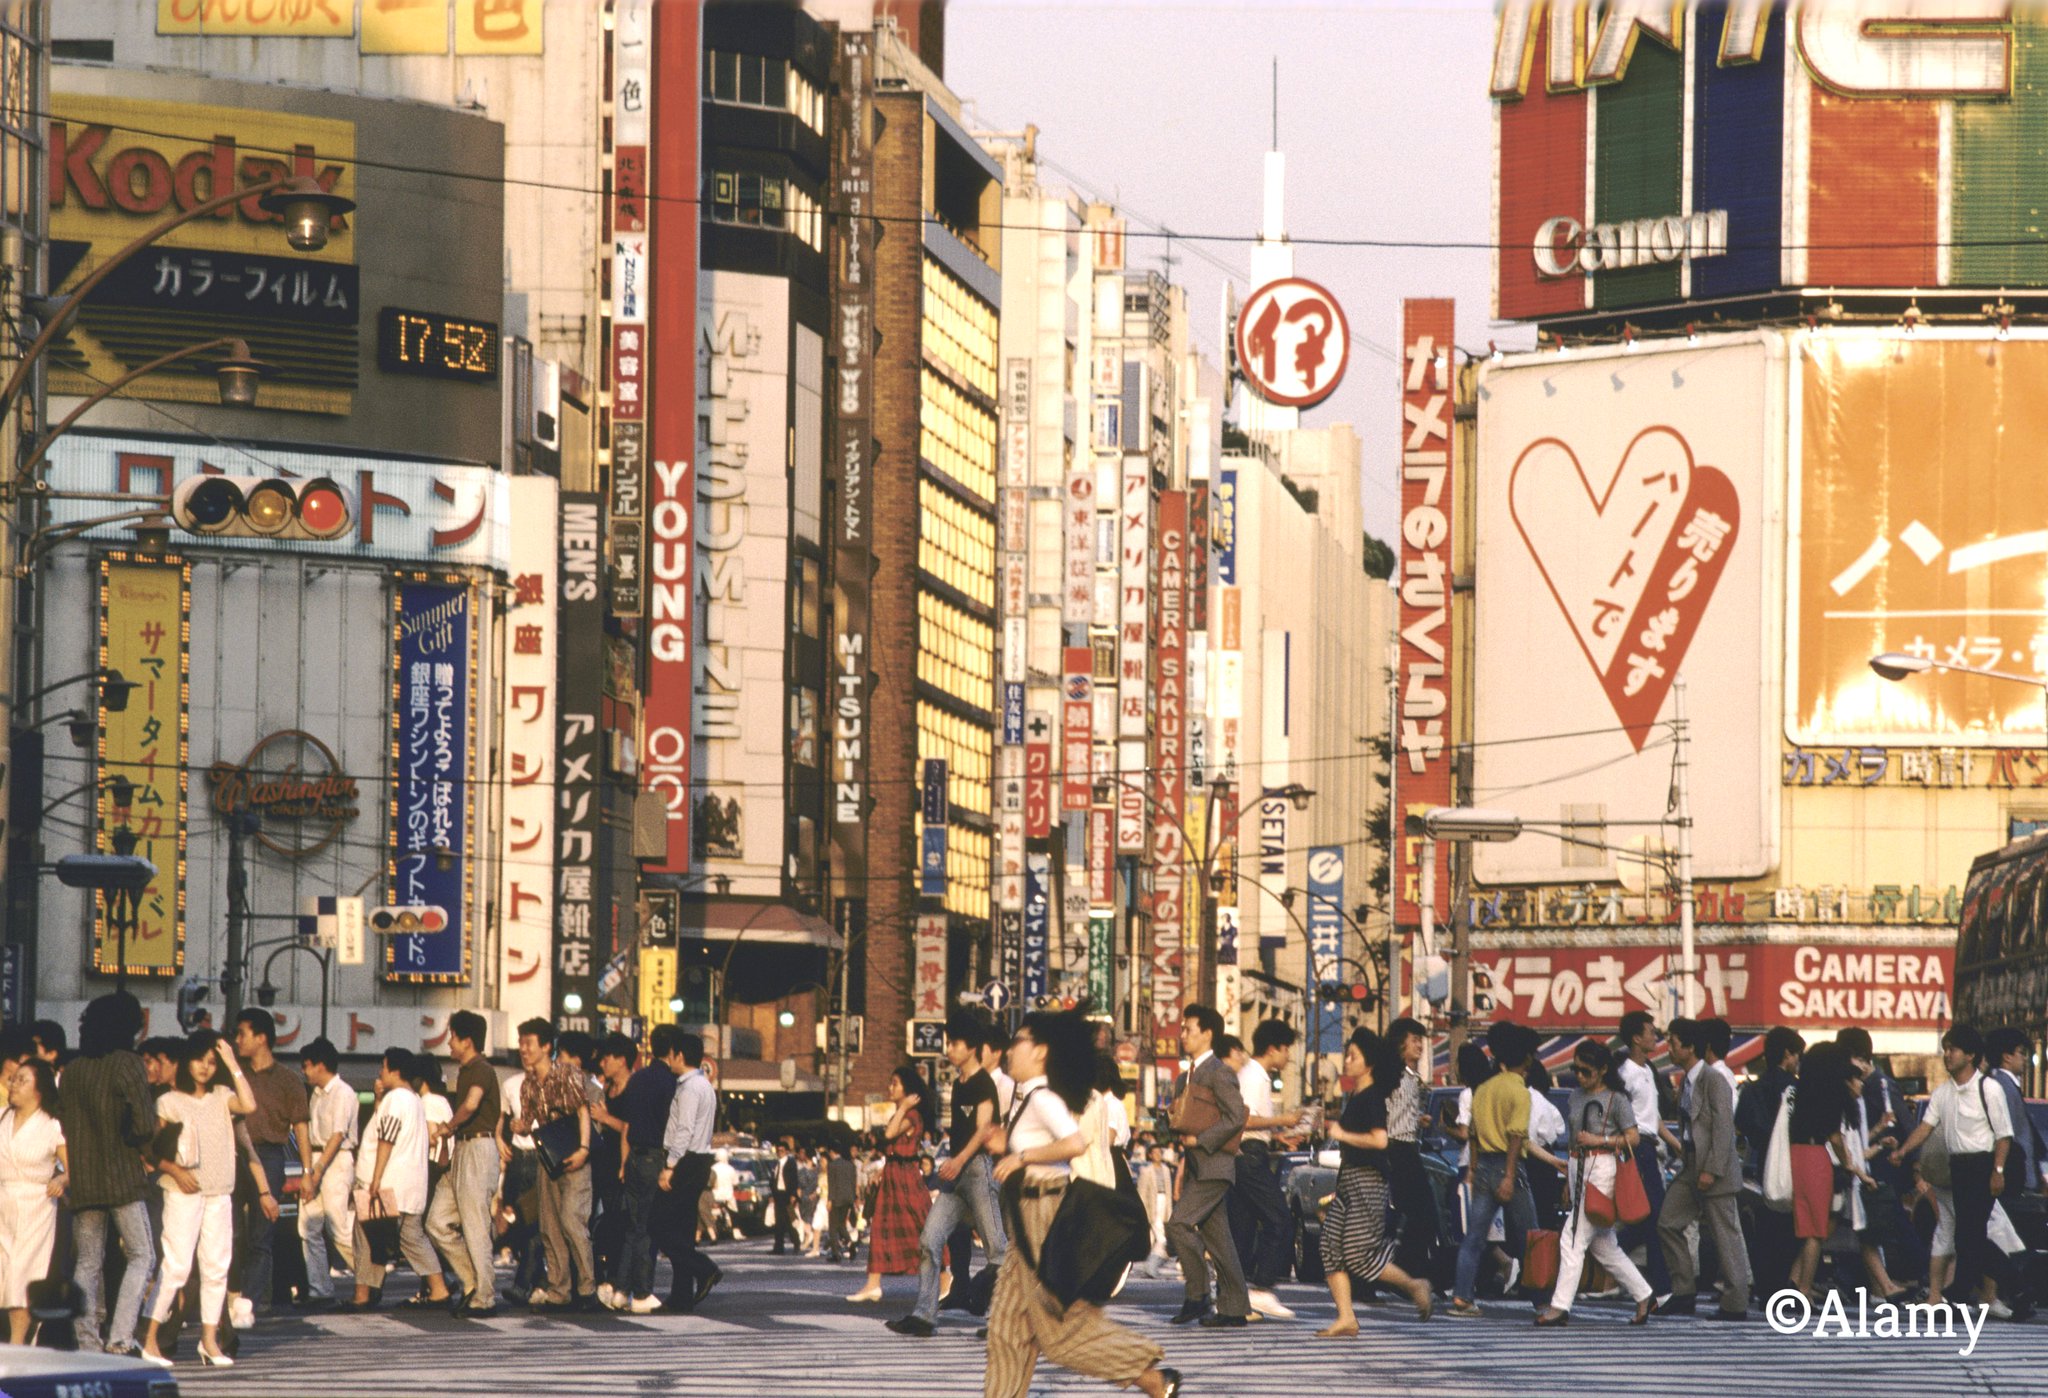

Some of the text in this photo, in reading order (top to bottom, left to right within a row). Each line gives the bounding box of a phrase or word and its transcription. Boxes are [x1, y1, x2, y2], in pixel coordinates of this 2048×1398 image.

[50, 121, 352, 232] Kodak
[153, 256, 349, 311] カラーフィルム
[1533, 209, 1728, 276] Canon
[117, 451, 486, 546] ワトン
[696, 310, 748, 740] MITSUMINE
[562, 503, 599, 601] MEN'S
[650, 460, 688, 662] YOUNG
[1122, 473, 1146, 717] アメリカ屋靴店
[1404, 336, 1448, 773] カメラのさくらや
[1591, 470, 1679, 639] ハートで
[401, 592, 467, 639] Summer
[418, 620, 455, 656] Gift
[1622, 507, 1732, 698] 売ります
[1158, 529, 1181, 815] CAMERA SAKURAYA
[836, 633, 863, 823] MITSUMINE
[1784, 748, 1889, 785] カメラ
[1901, 747, 1972, 786] 時計
[209, 761, 361, 816] Washington
[510, 573, 548, 984] 銀座ワシントン
[1029, 752, 1046, 827] クスリ
[1120, 772, 1142, 844] LADY'S
[557, 713, 596, 977] アメリカ屋靴店
[1260, 786, 1286, 875] ISETAN
[1153, 820, 1184, 1028] カメラのさくらや
[1774, 884, 1848, 922] 時計
[1780, 982, 1954, 1021] SAKURAYA
[1794, 946, 1944, 985] CAMERA
